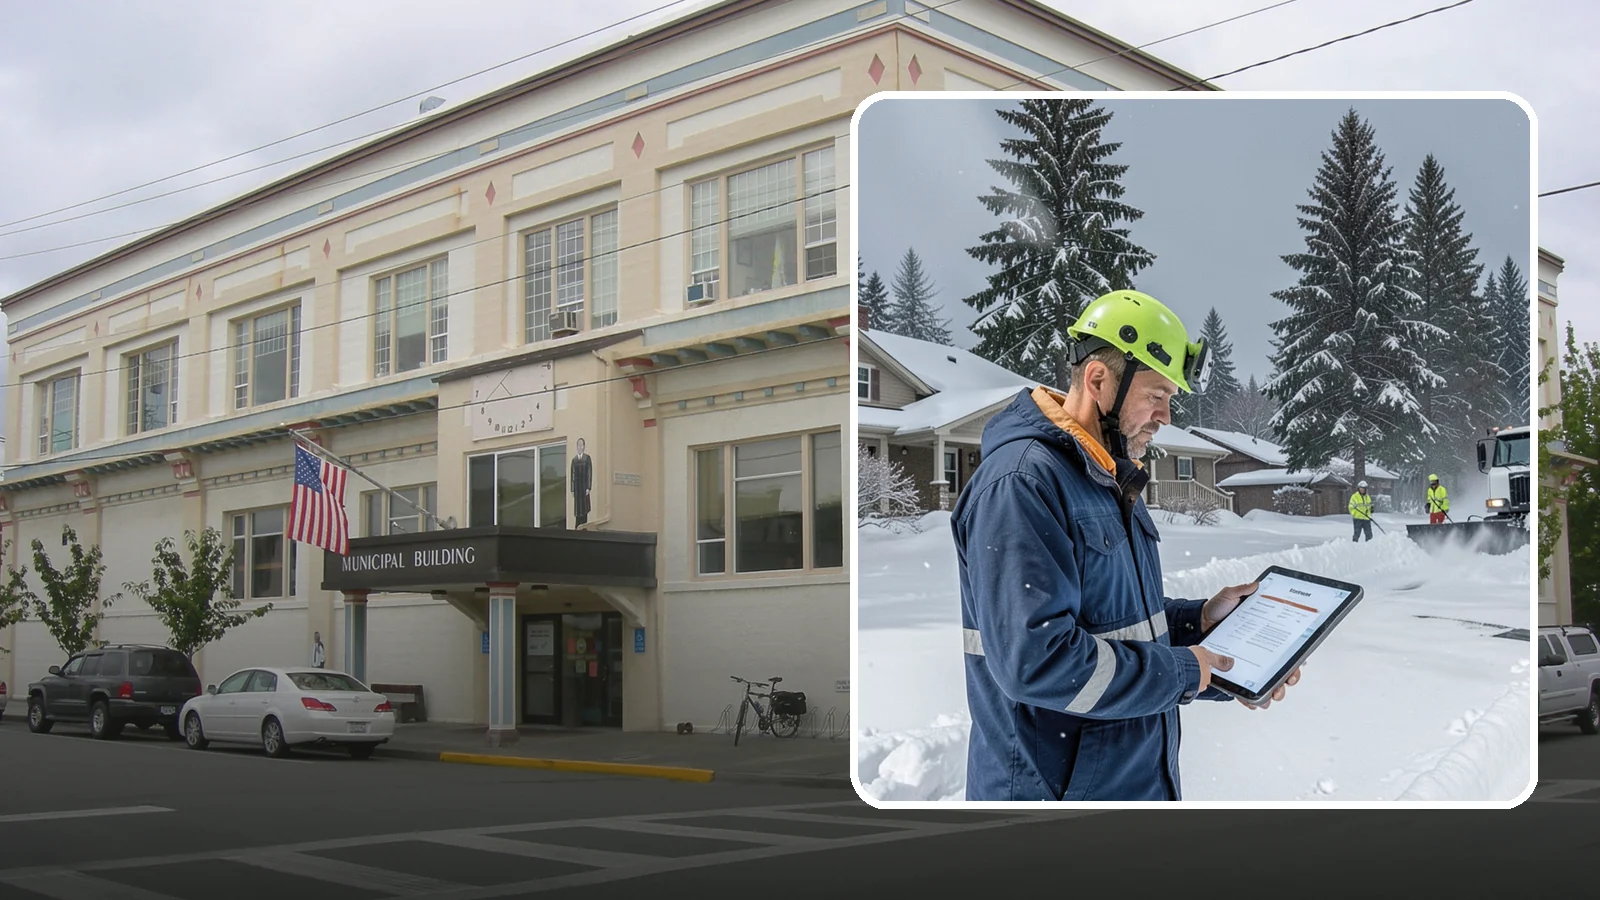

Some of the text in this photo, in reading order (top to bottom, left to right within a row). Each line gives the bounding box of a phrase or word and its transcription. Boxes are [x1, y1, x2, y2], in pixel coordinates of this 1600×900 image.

[475, 389, 479, 398] 7
[480, 407, 485, 415] 8
[487, 418, 492, 426] 9
[521, 420, 526, 428] 2
[528, 414, 533, 422] 3
[342, 546, 475, 572] MUNICIPAL BUILDING
